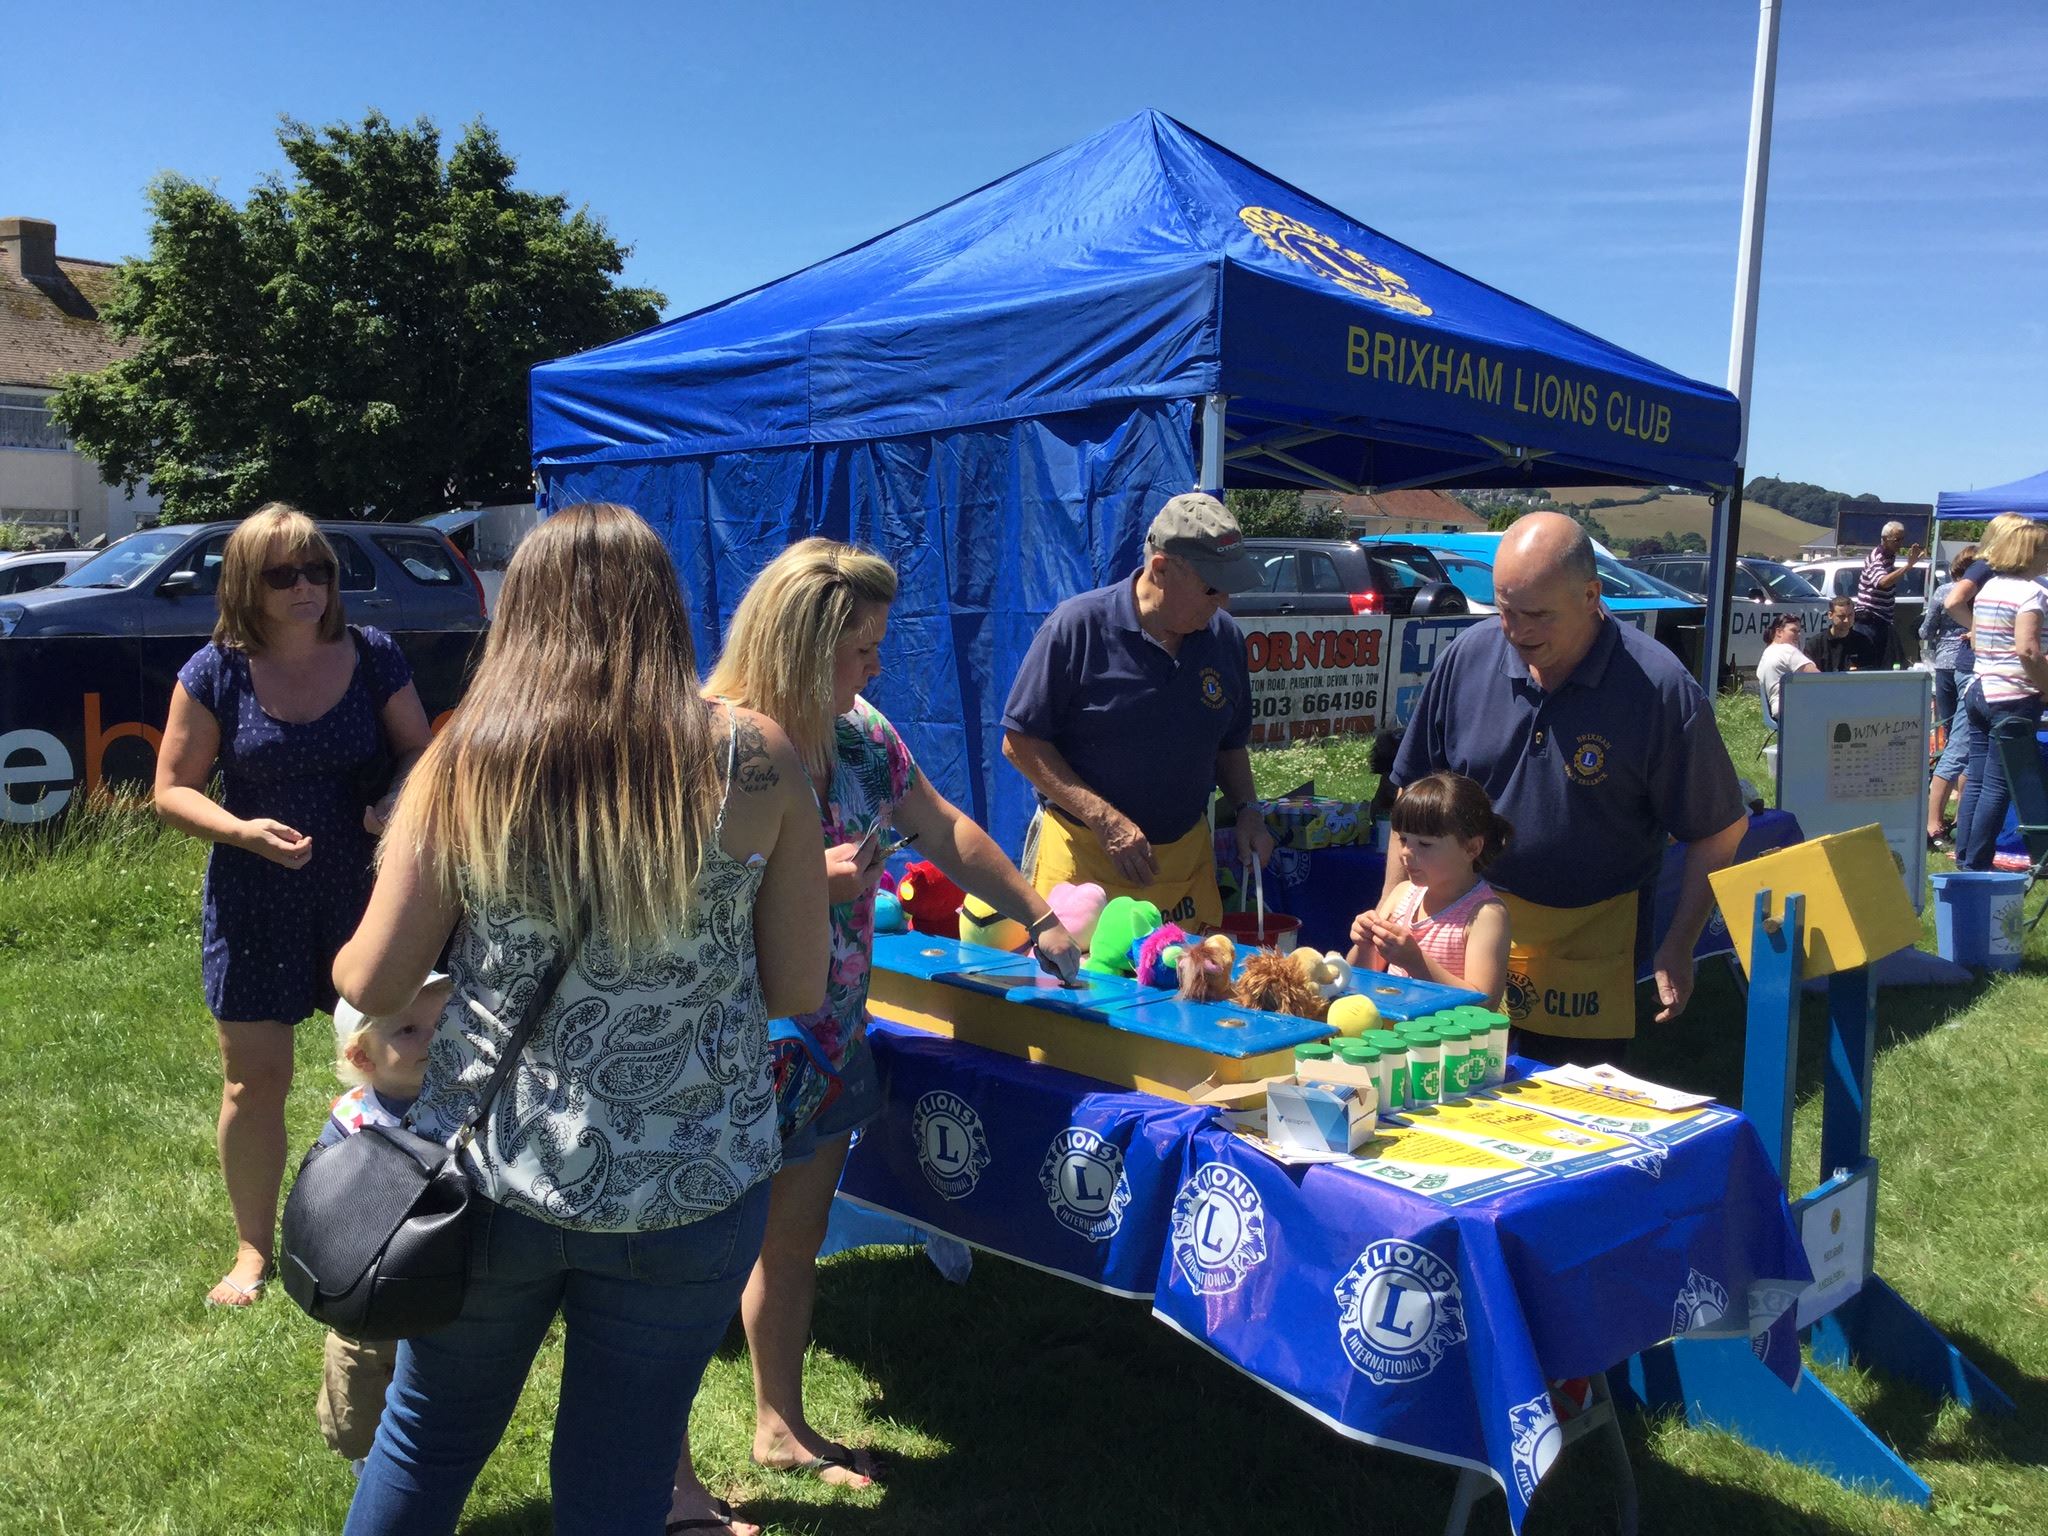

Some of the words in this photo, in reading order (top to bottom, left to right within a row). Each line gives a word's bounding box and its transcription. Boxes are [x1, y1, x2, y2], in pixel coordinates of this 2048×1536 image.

[1347, 325, 1504, 405] BRIXHAM
[1514, 367, 1598, 426] LIONS
[1606, 391, 1672, 443] CLUB
[1246, 628, 1382, 673] ORNISH
[1250, 678, 1265, 693] TON
[1250, 695, 1292, 719] 803
[1302, 689, 1378, 715] 664196
[1543, 988, 1601, 1018] CLUB
[922, 1094, 973, 1124] LIONS
[936, 1124, 960, 1164] L
[1057, 1131, 1113, 1160] LIONS
[1072, 1164, 1105, 1201] L
[1201, 1203, 1224, 1254] L
[1372, 1244, 1451, 1289] LIONS
[1375, 1281, 1414, 1339] L
[1347, 1333, 1426, 1375] INTERNATIONAL
